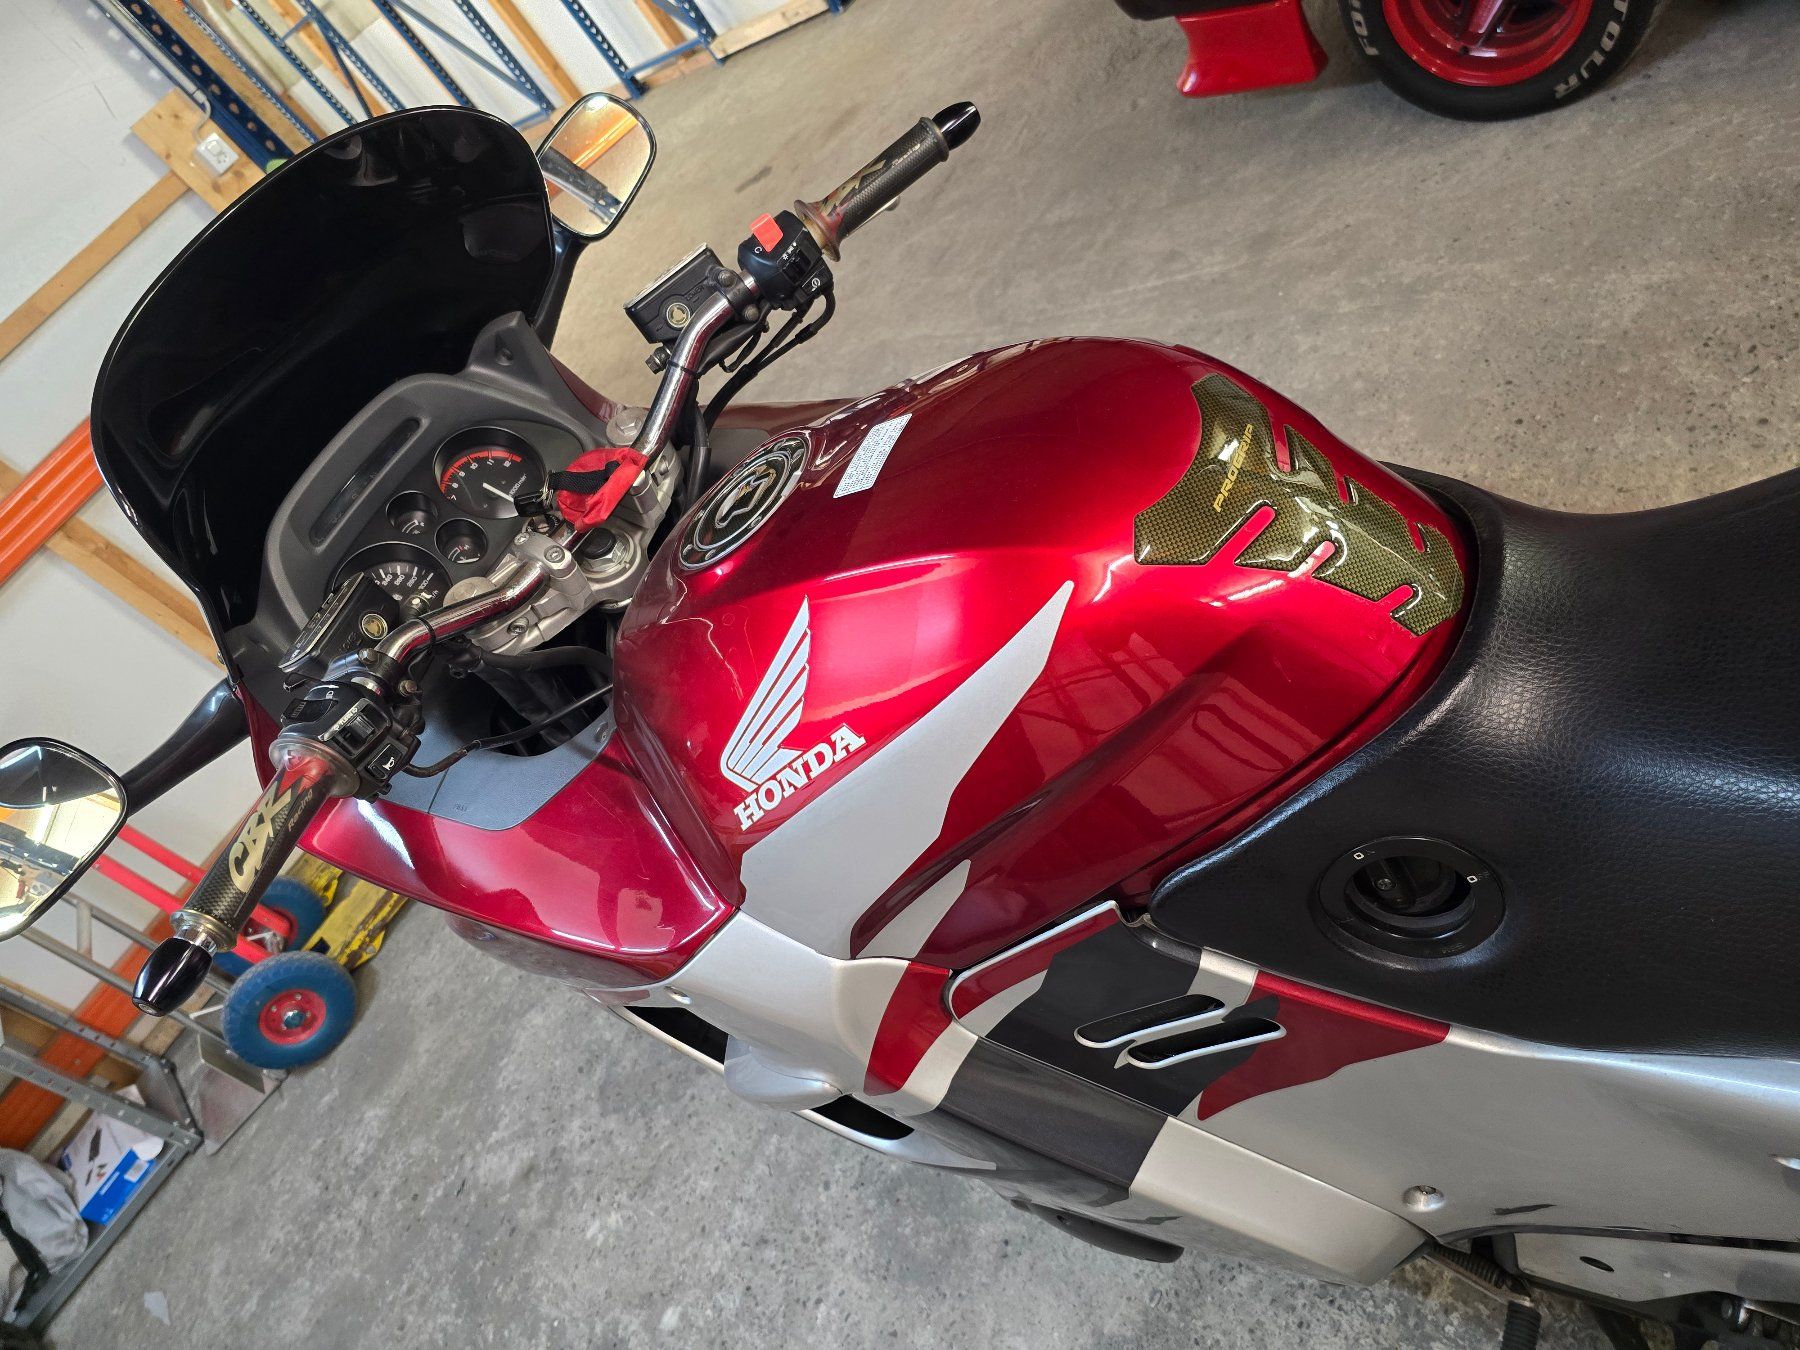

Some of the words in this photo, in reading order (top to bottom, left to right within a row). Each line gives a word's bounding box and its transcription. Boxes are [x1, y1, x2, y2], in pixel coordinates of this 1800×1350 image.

[1350, 0, 1379, 55] FO
[1213, 423, 1254, 513] PROGRIP
[287, 788, 314, 833] Racing
[733, 724, 867, 832] HONDA
[228, 780, 292, 894] CBR
